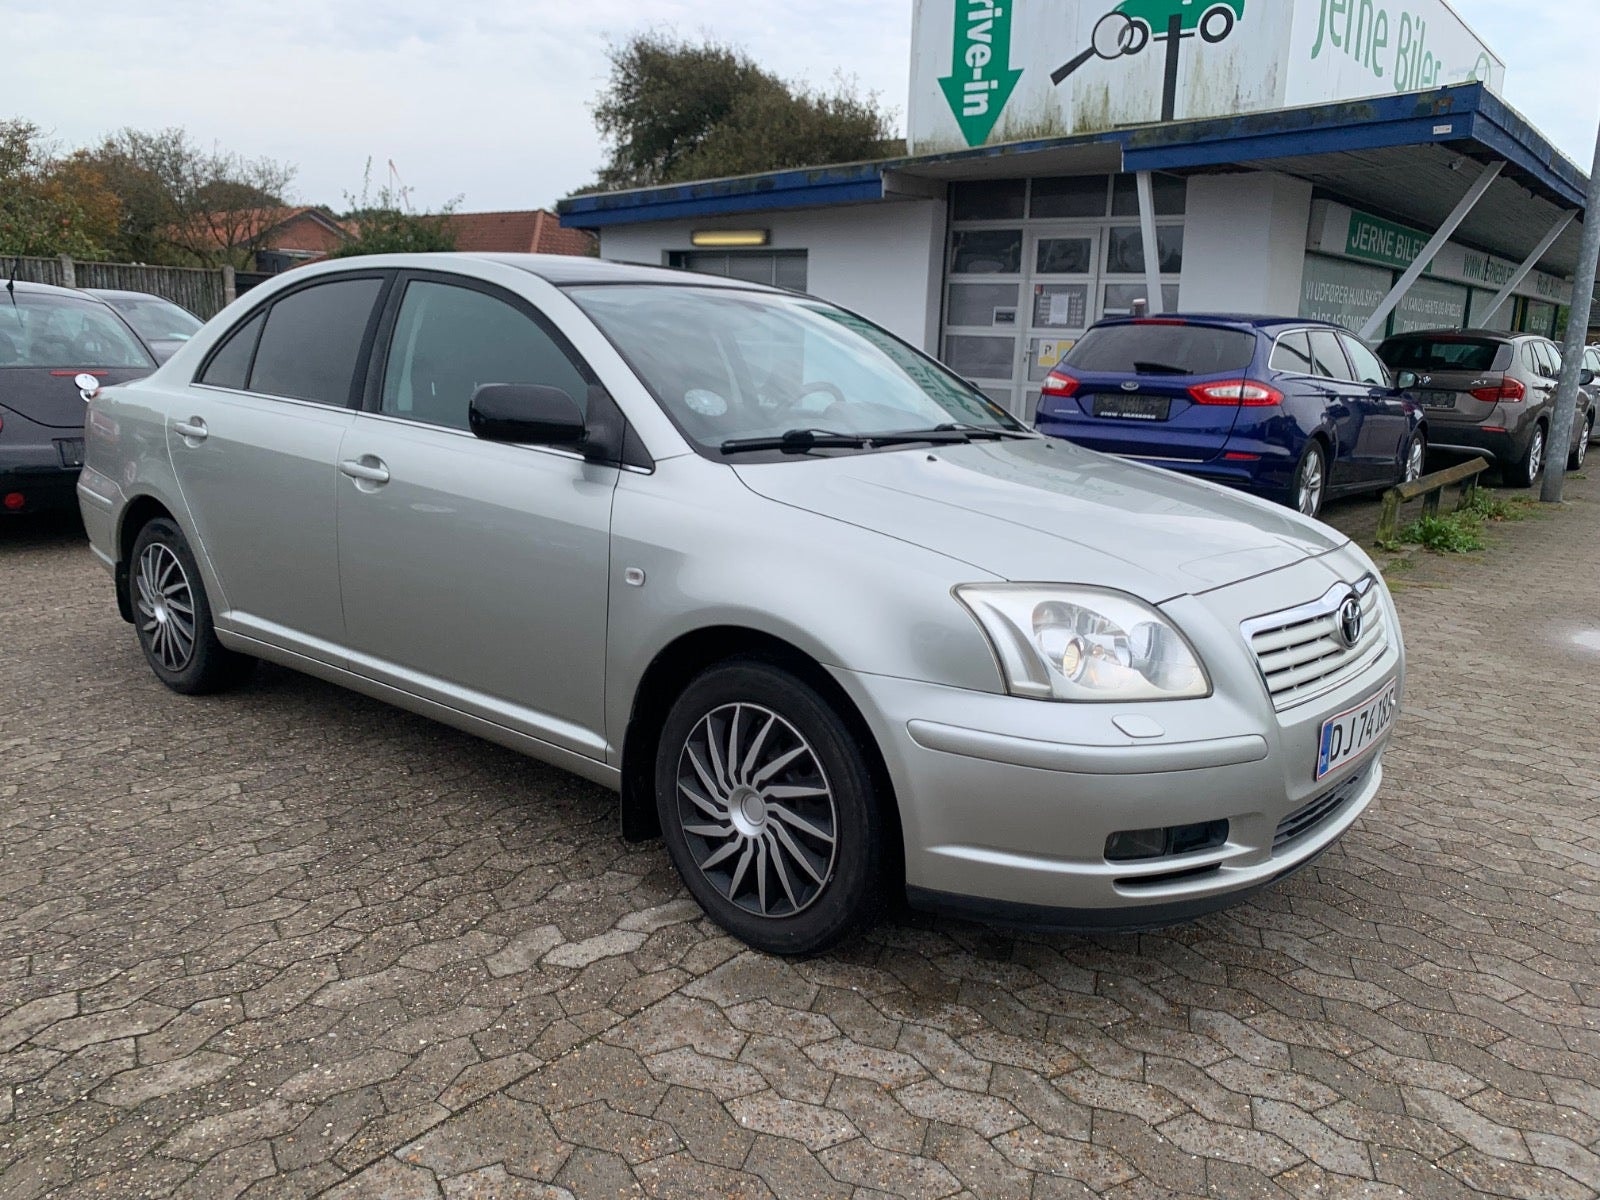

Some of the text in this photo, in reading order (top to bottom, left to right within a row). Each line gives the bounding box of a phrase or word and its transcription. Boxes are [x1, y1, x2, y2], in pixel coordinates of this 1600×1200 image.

[1351, 222, 1395, 256] JERNE
[1330, 717, 1356, 762] DJ
[1357, 704, 1376, 748] 74
